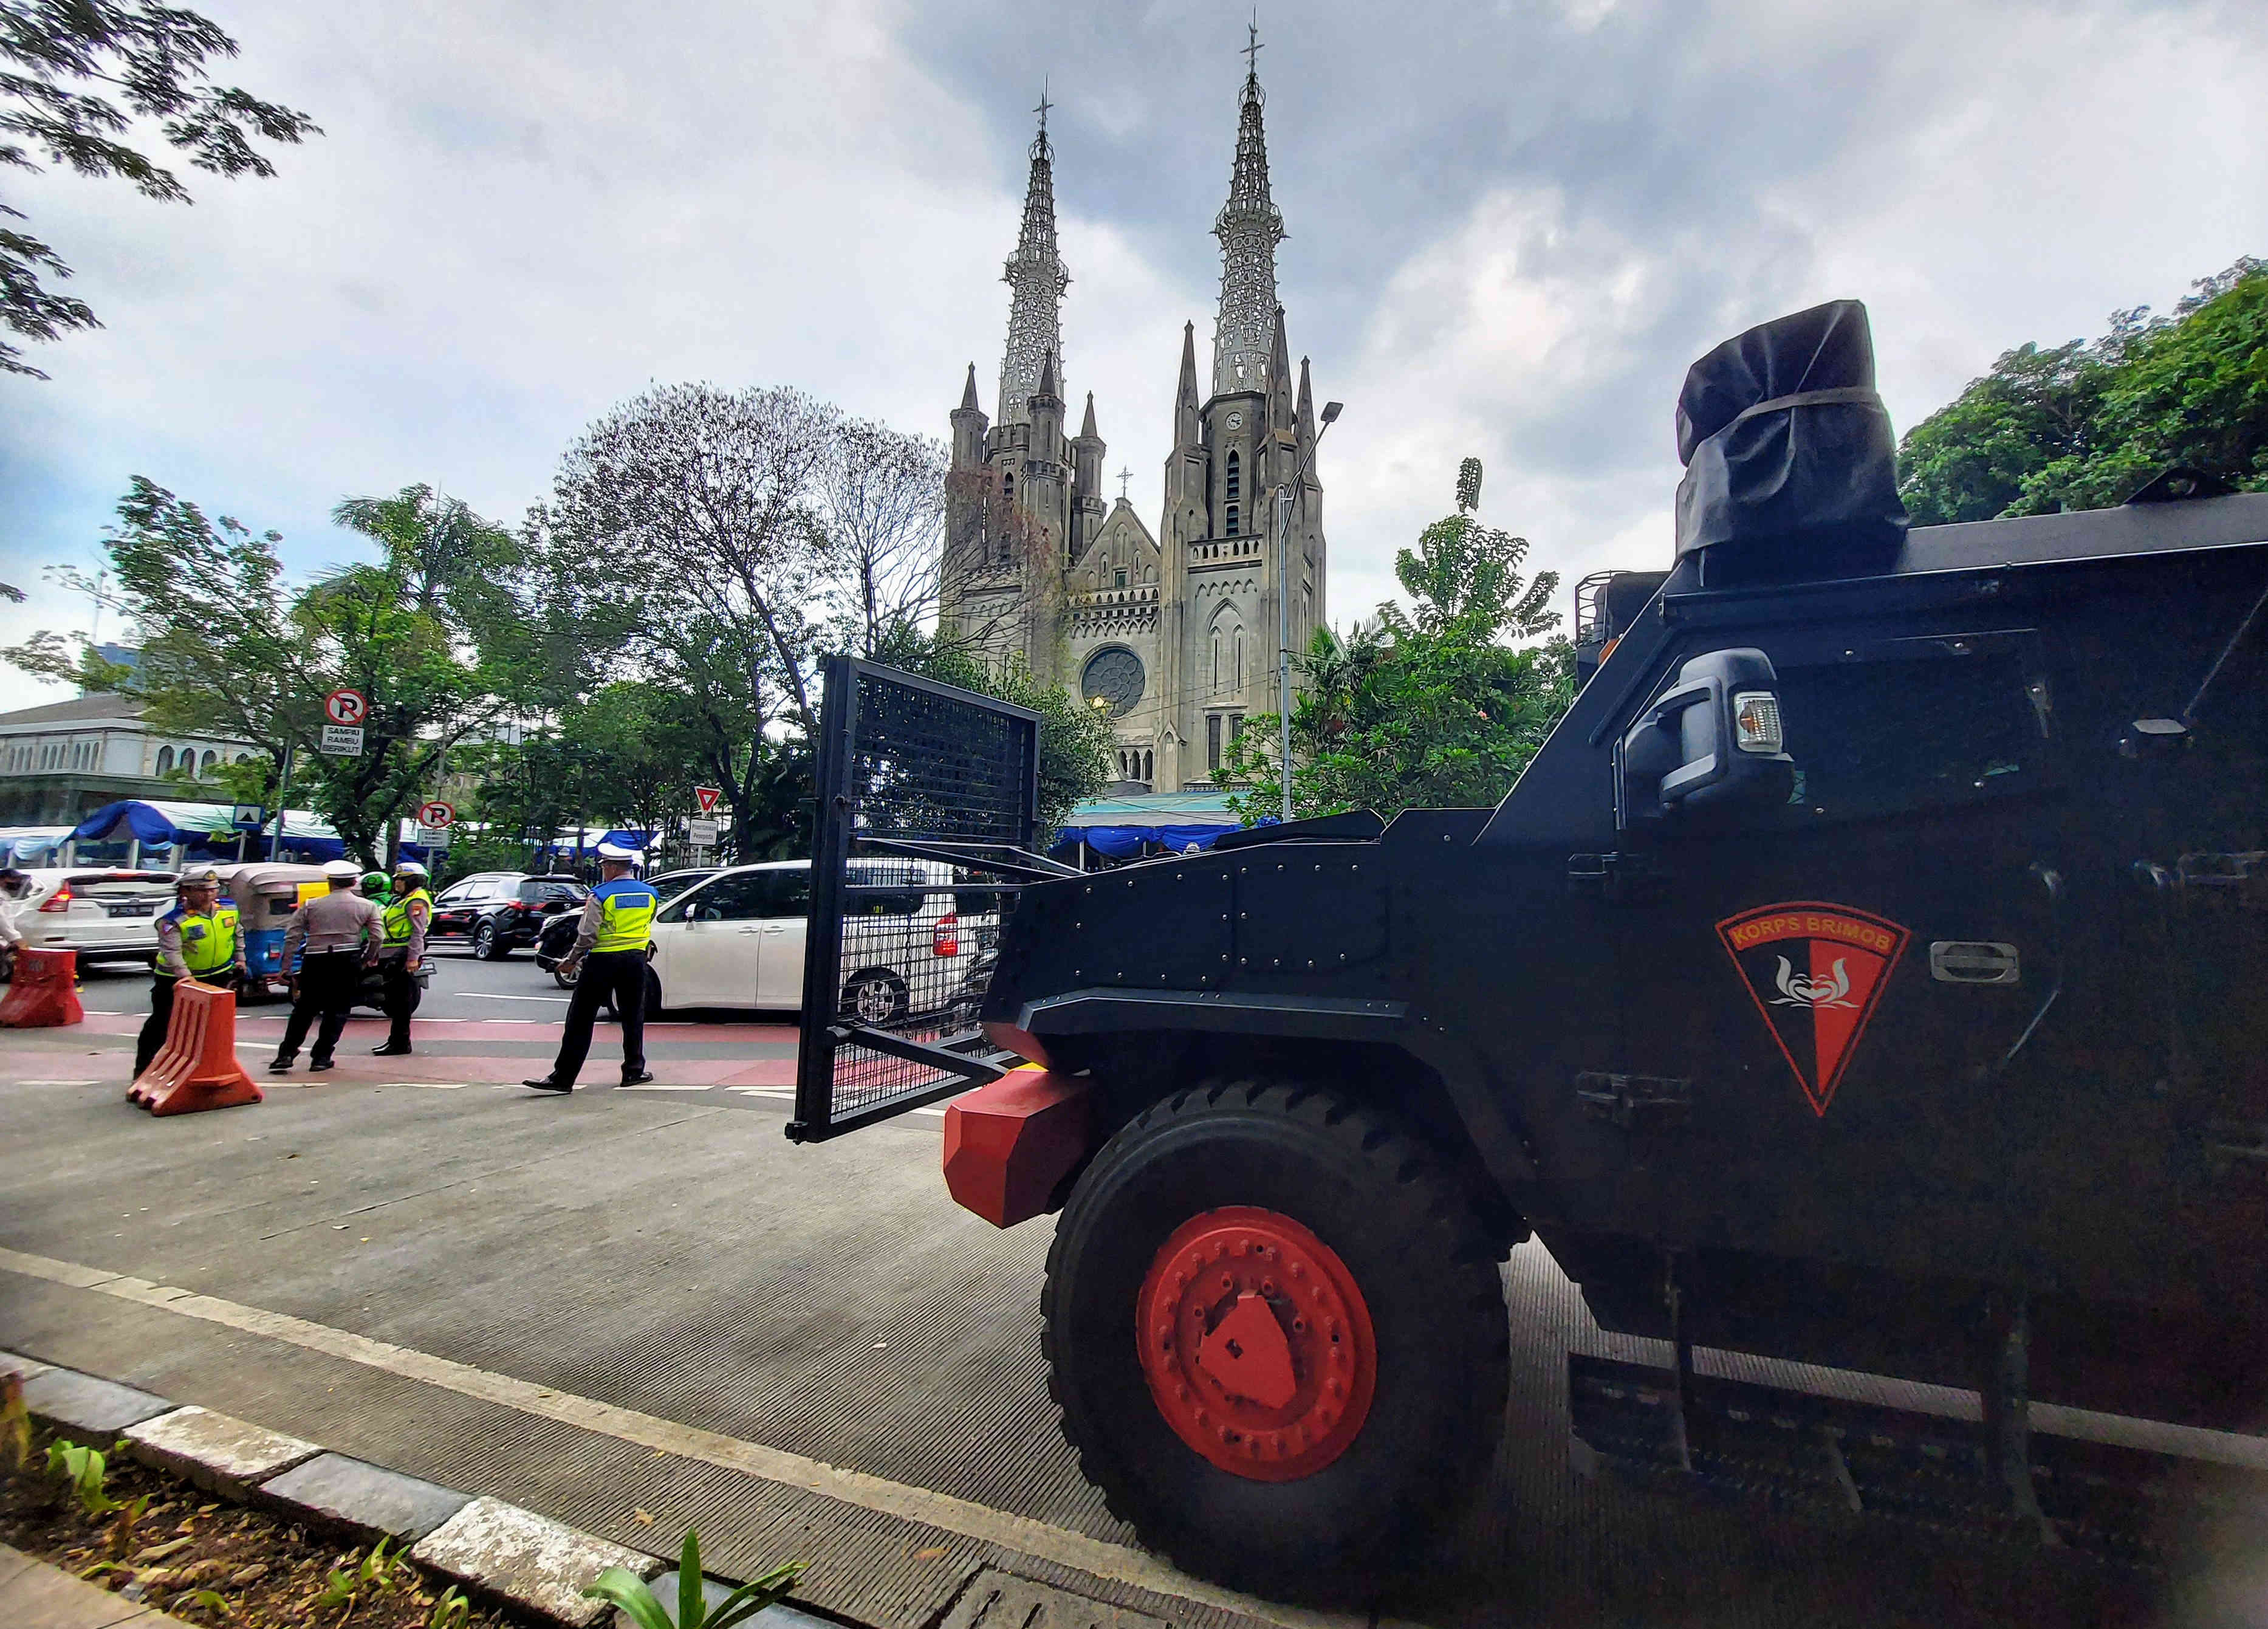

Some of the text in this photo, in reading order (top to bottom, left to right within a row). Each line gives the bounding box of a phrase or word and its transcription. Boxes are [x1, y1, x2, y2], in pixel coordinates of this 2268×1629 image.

[327, 727, 360, 736] SAMPAI
[327, 736, 358, 744] RAMBU
[1733, 917, 1890, 950] KORPS BRIMOB
